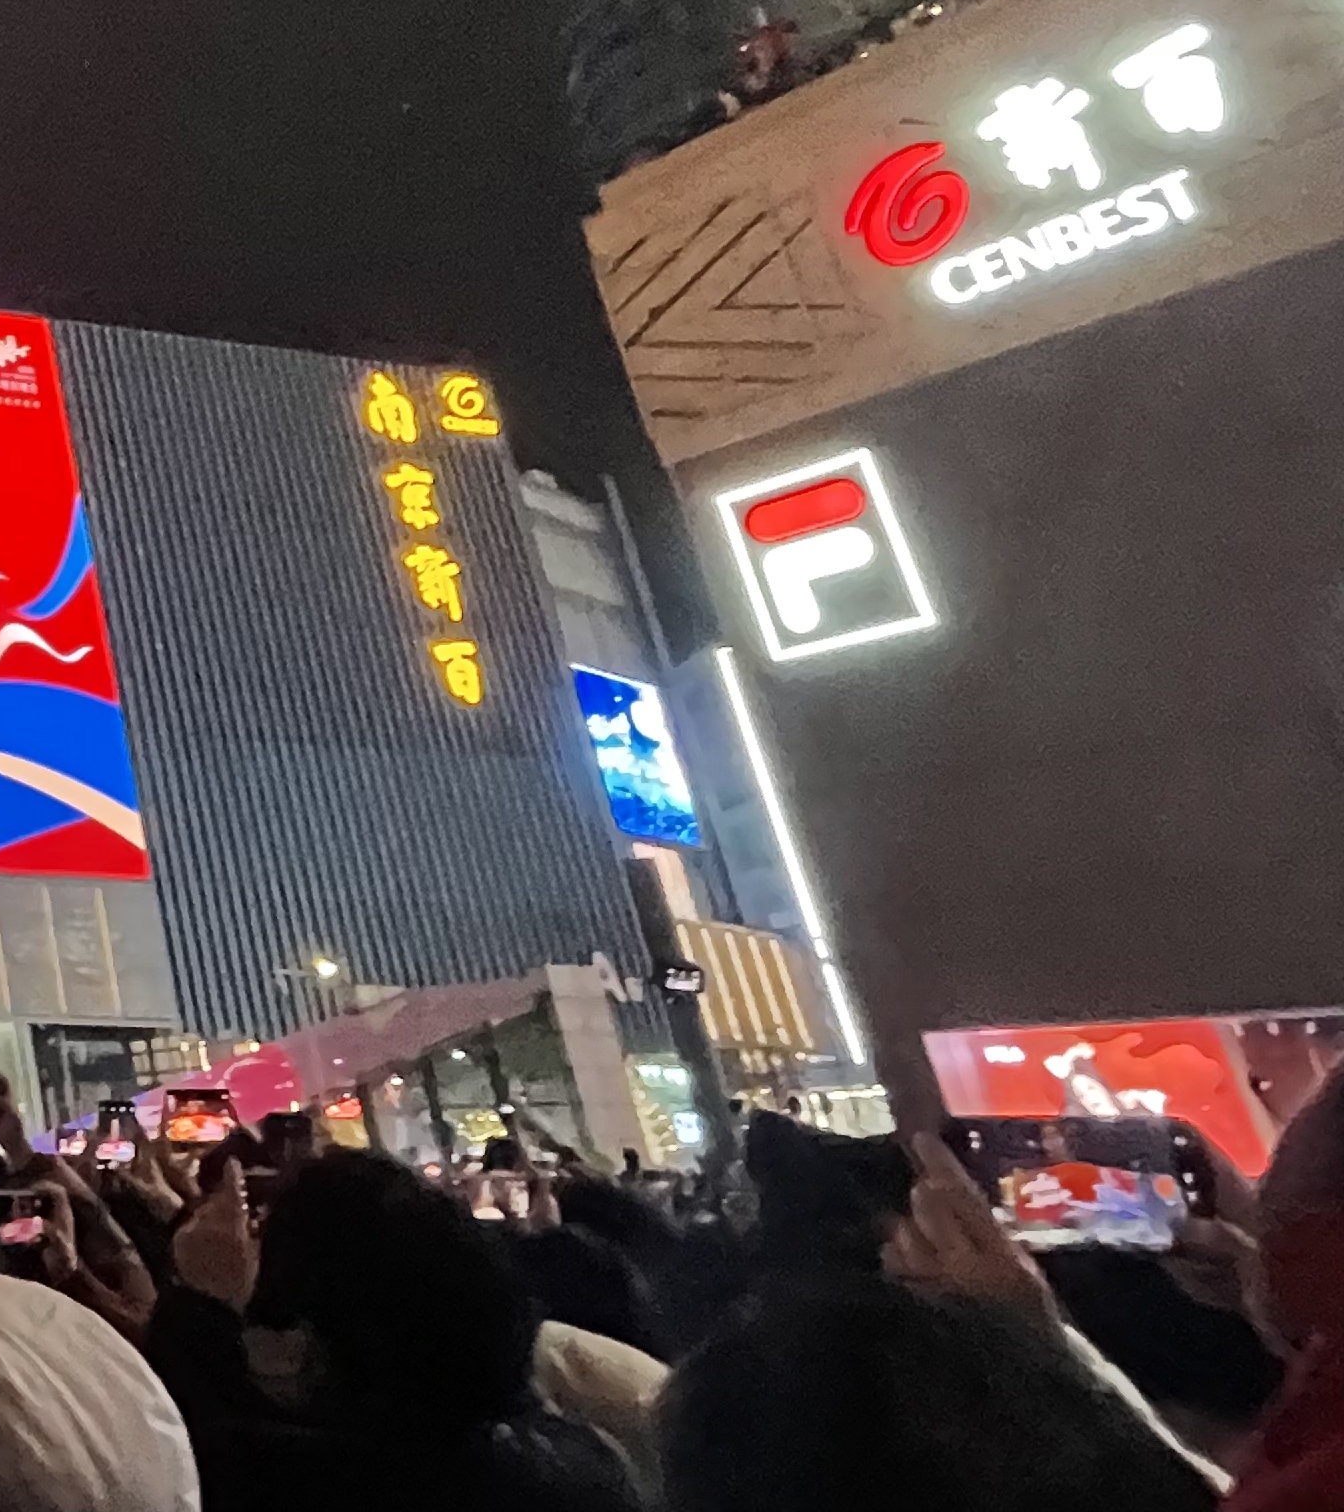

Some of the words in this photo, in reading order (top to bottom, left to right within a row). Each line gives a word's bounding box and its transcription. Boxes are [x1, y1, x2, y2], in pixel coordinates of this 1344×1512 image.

[929, 168, 1198, 303] CENBEST
[367, 370, 483, 705] 南京新百
